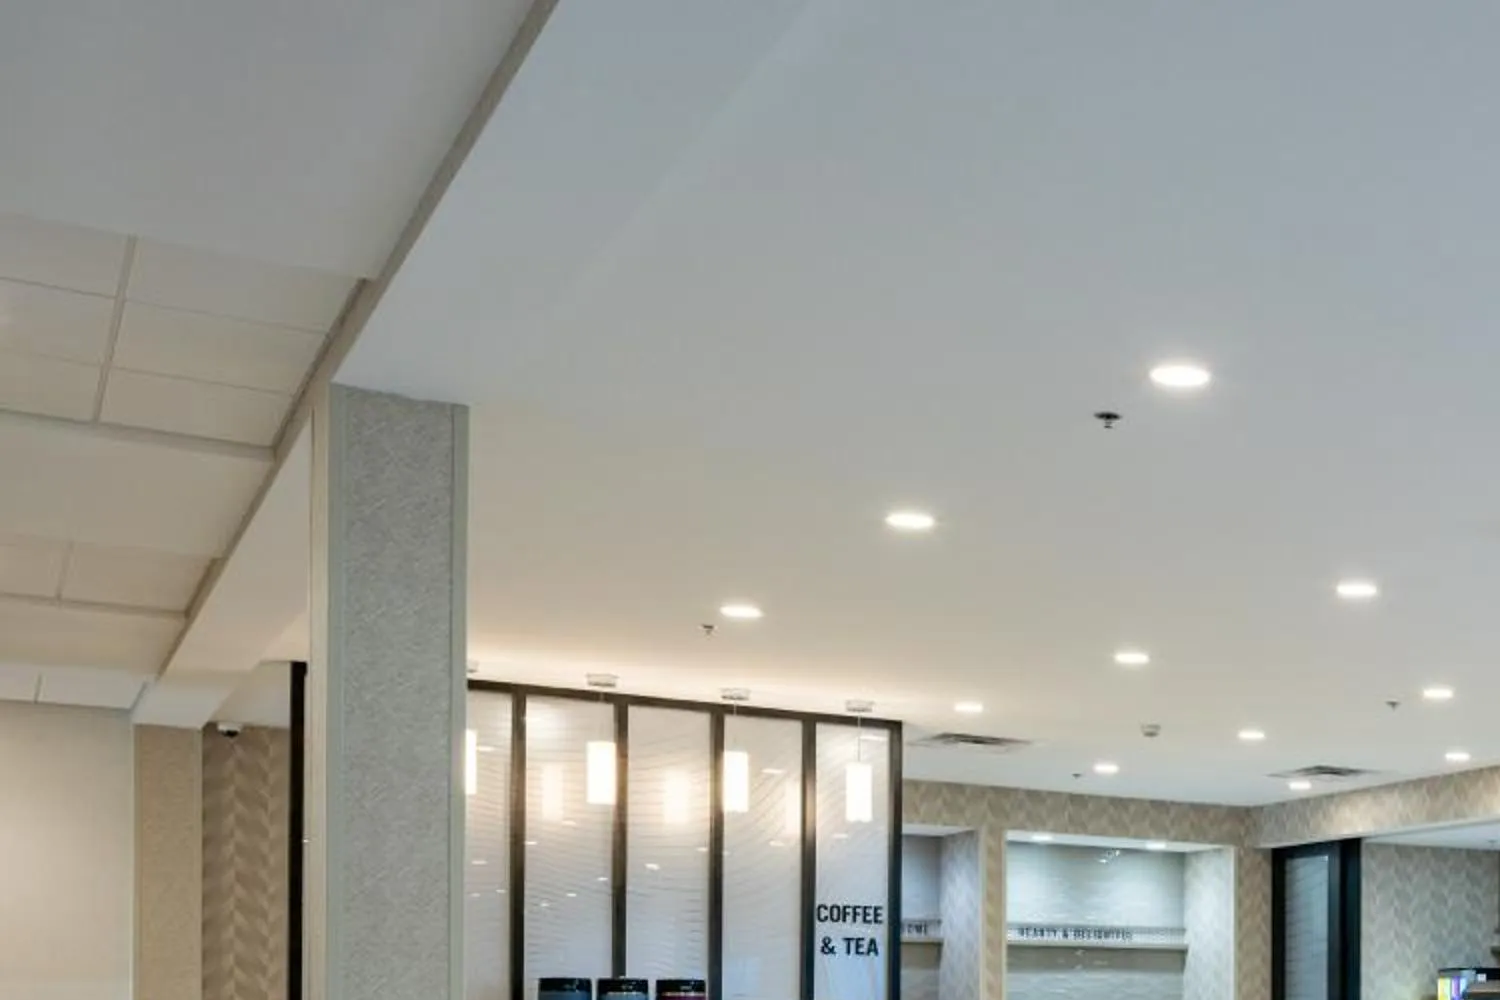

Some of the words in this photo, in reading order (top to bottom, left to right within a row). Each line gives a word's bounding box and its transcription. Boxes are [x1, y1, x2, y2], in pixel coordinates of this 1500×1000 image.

[817, 904, 883, 924] COFFEE
[820, 936, 836, 955] &
[842, 937, 879, 956] TEA
